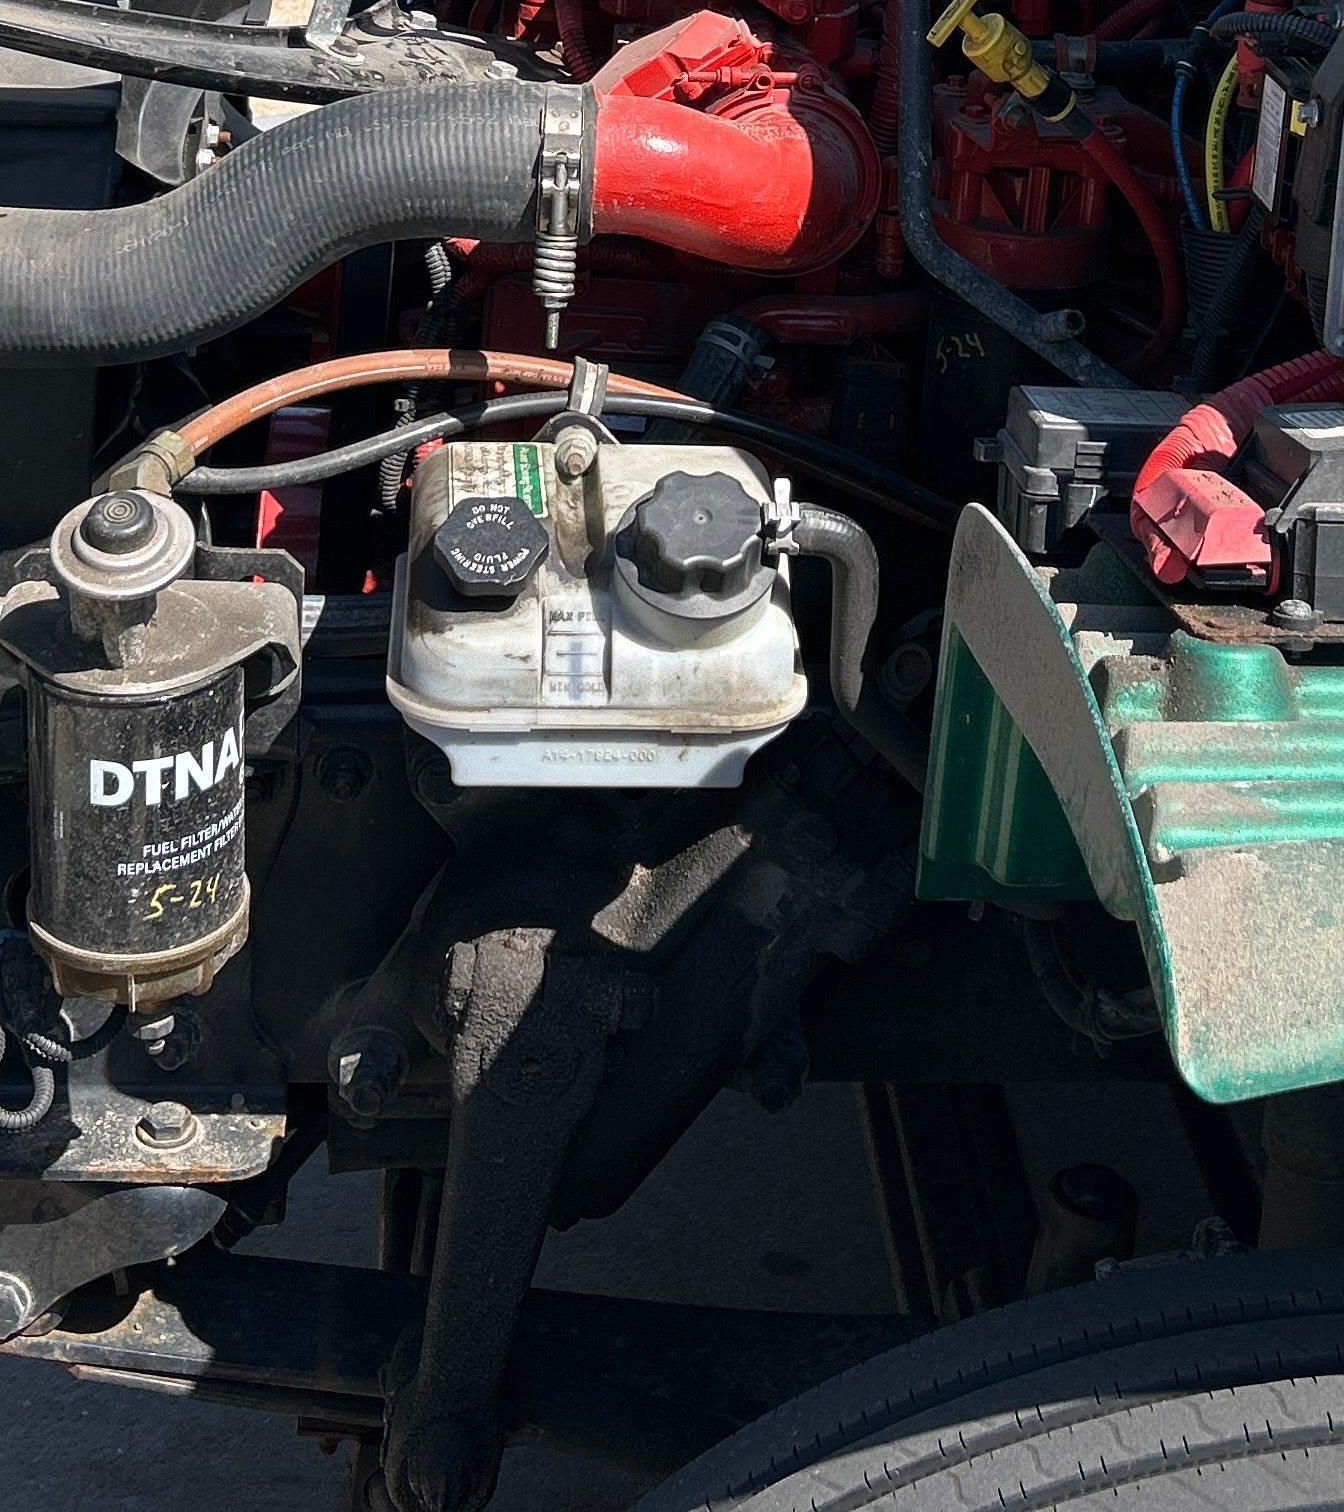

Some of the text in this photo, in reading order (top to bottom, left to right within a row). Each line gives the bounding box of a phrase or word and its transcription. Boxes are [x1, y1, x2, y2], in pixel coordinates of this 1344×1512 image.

[472, 503, 510, 515] DO NOT
[466, 514, 515, 530] OVERFILL
[450, 547, 530, 575] POWER STEERING
[473, 551, 509, 564] FLUID
[549, 610, 573, 624] MAX
[549, 680, 569, 693] MIN
[90, 727, 240, 806] DTNA
[143, 841, 179, 858] FUEL
[117, 842, 213, 875] REPLACEMENT
[142, 872, 220, 921] 5-24
